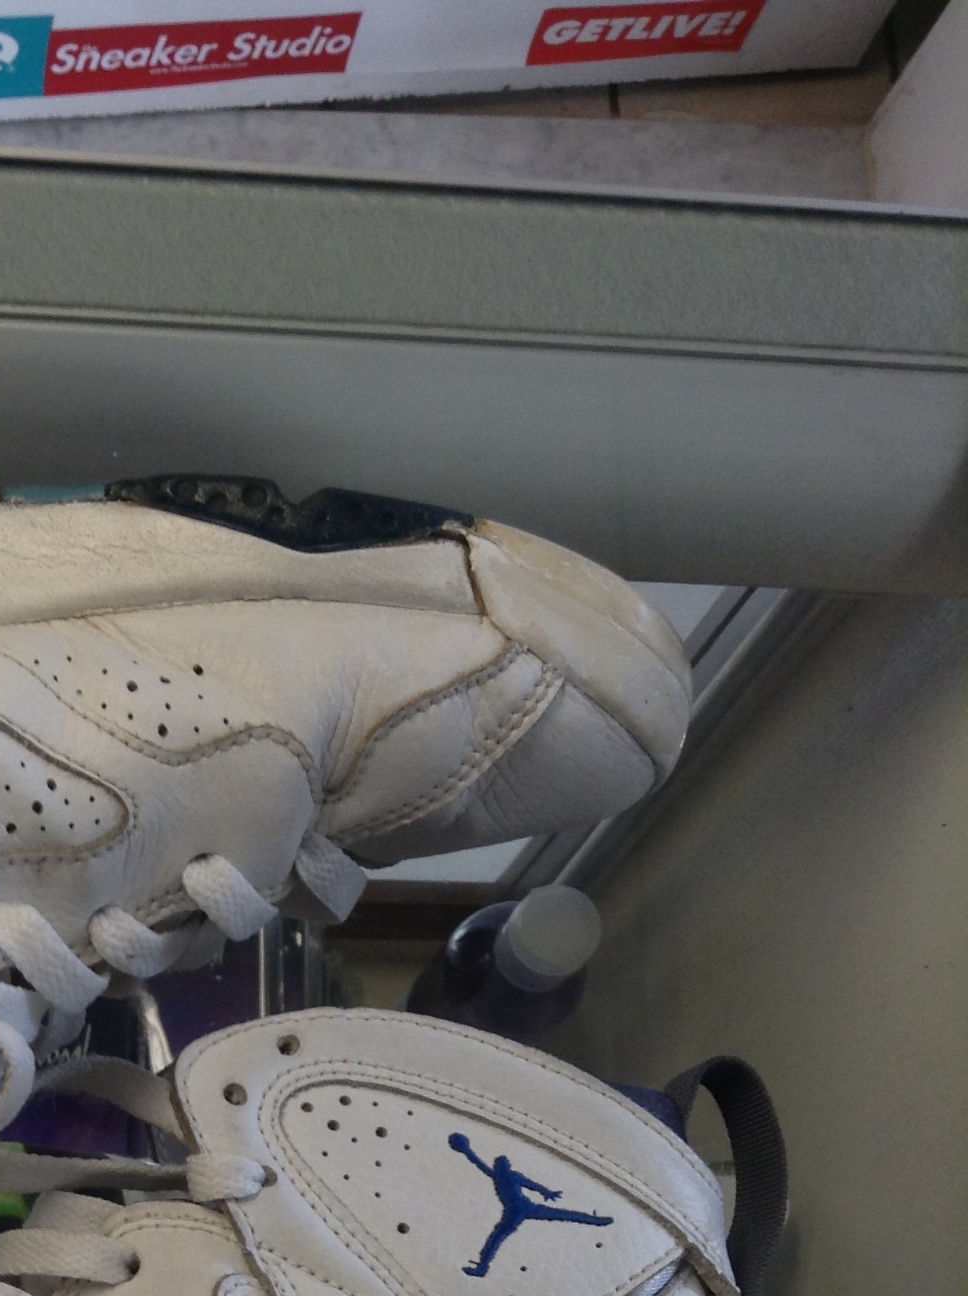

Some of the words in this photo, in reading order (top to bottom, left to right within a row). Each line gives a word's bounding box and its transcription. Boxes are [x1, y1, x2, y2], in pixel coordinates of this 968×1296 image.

[542, 10, 747, 46] GETLIVE!
[50, 34, 219, 75] Sneaker
[227, 25, 352, 62] Studio
